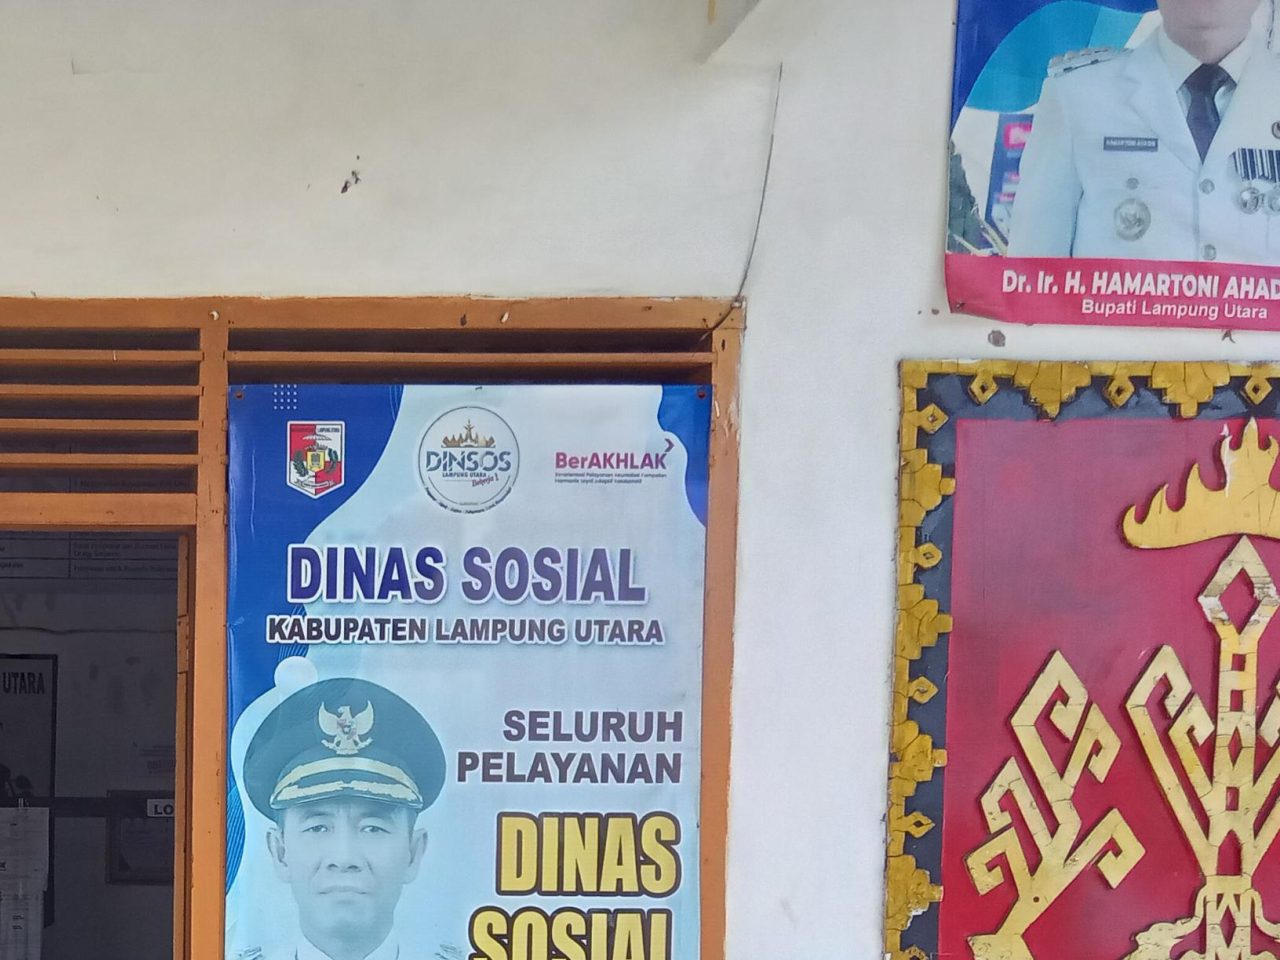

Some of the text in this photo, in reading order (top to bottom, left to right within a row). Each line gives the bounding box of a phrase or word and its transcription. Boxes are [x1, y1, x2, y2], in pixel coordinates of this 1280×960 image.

[1002, 270, 1031, 293] Dr.
[1037, 270, 1058, 294] Ir.
[1064, 271, 1086, 294] H.
[1091, 271, 1219, 298] HAMARTONI
[1081, 298, 1268, 320] Bupati Lampung Utara
[426, 450, 512, 472] DINSOS
[555, 452, 667, 470] BerAKHLAK
[289, 545, 646, 603] DINAS SOSIAL
[268, 617, 664, 643] KABUPATEN LAMPUNG UTARA
[2, 671, 45, 695] UTARA
[503, 709, 683, 743] SELURUH
[457, 752, 682, 784] PELAYANAN
[496, 811, 682, 897] DINAS
